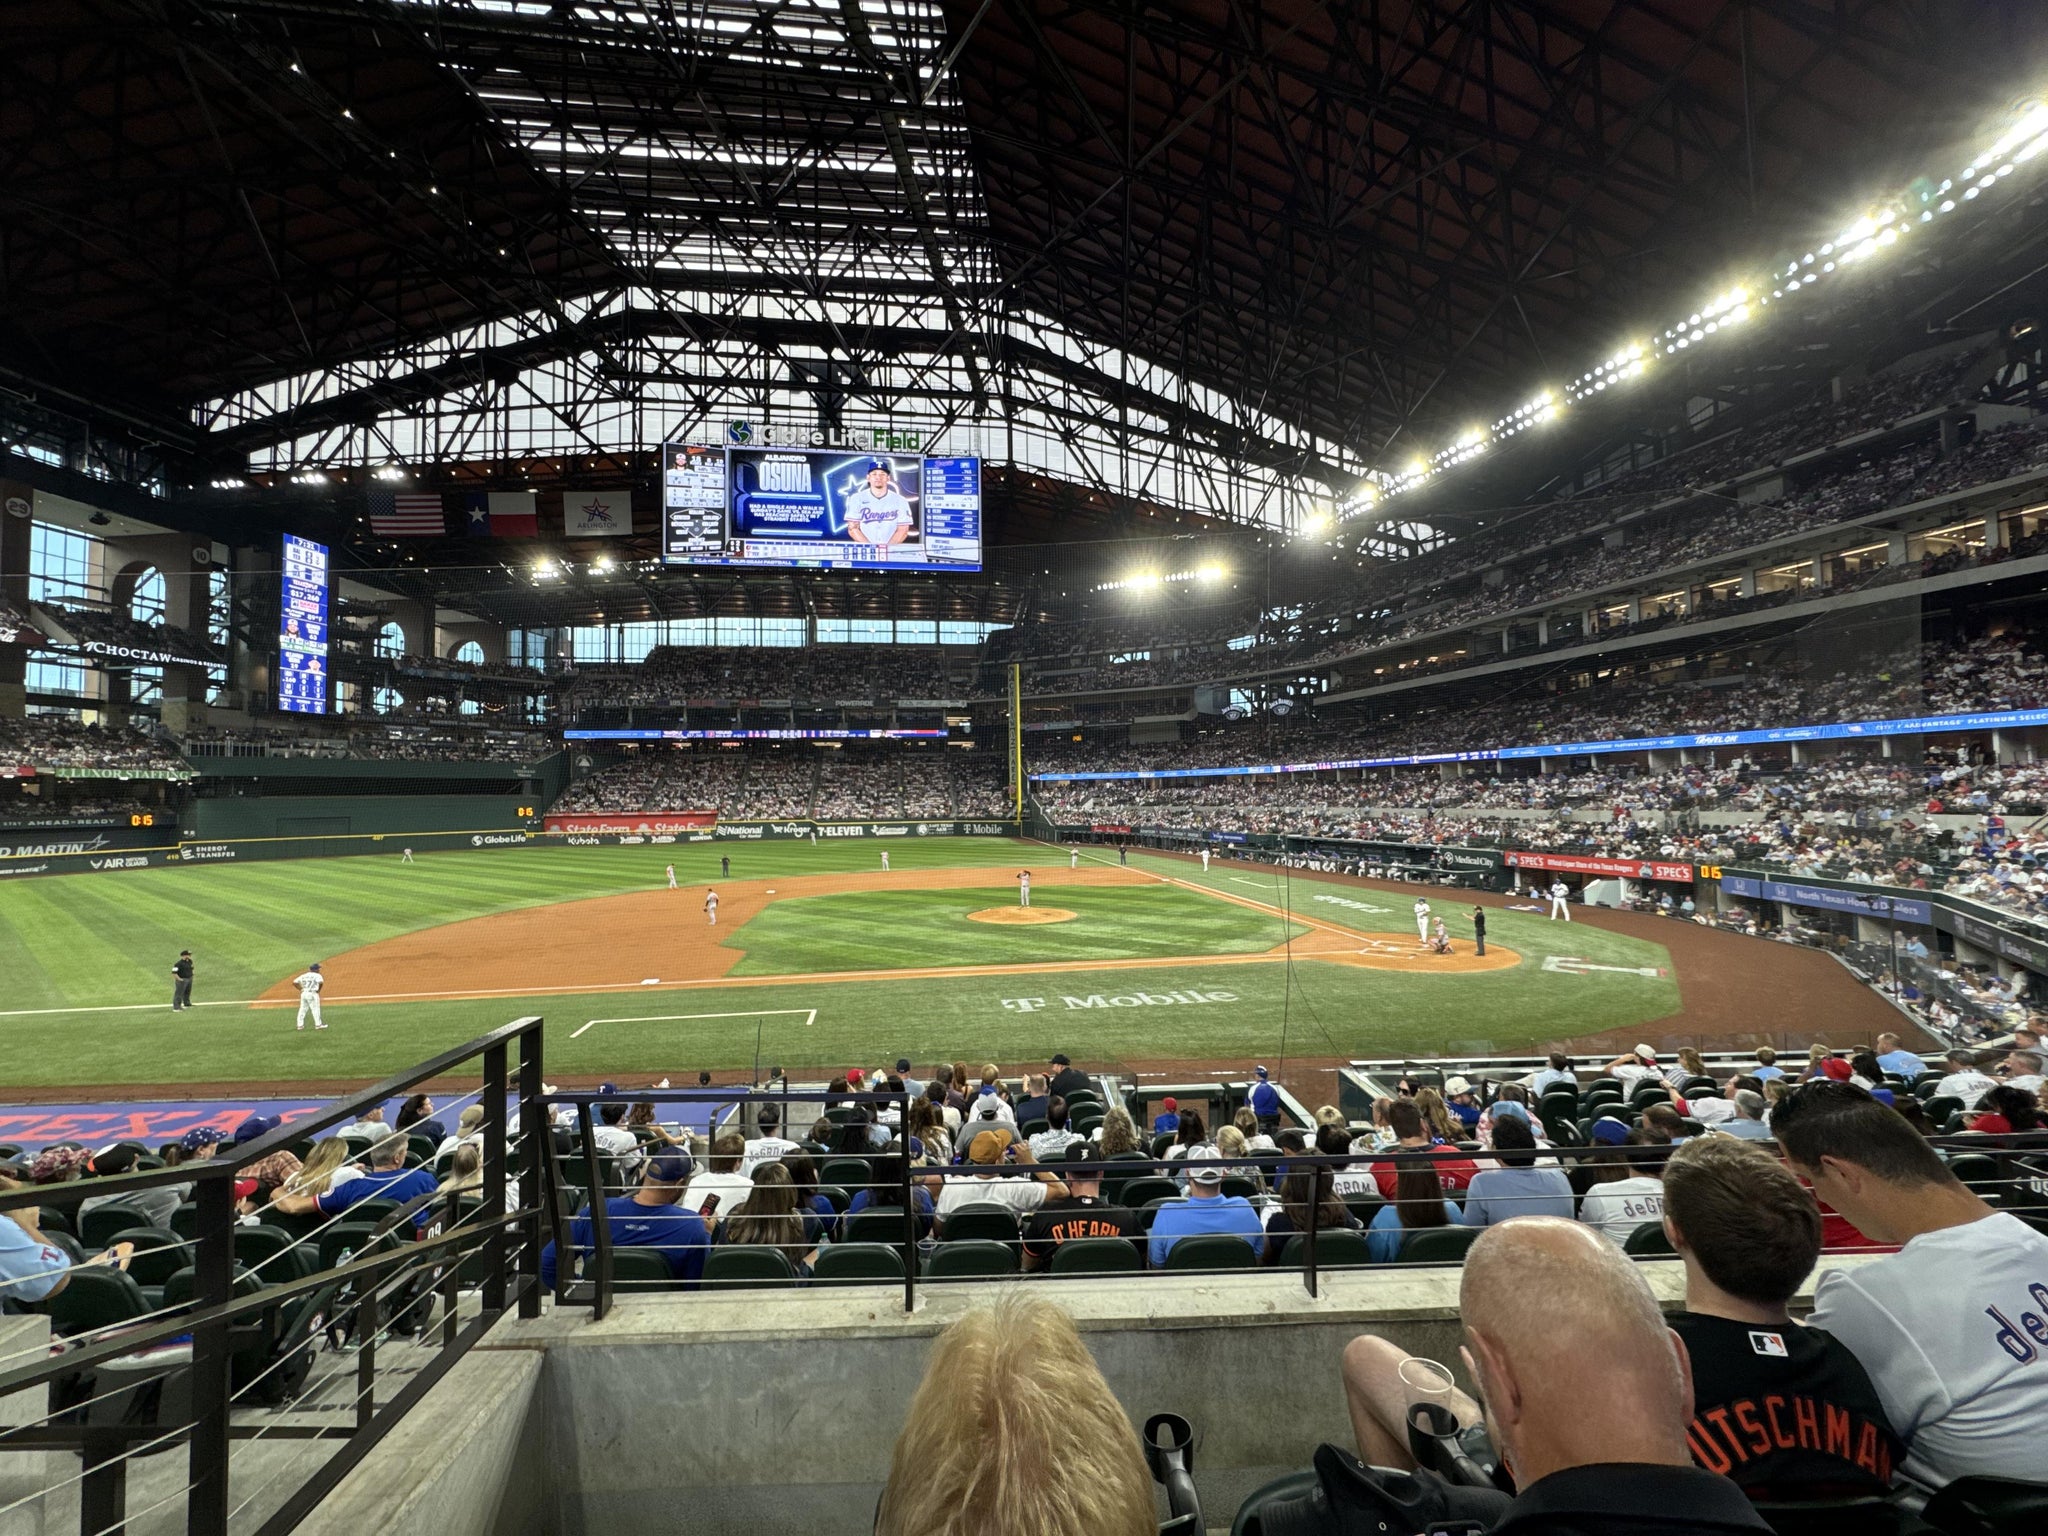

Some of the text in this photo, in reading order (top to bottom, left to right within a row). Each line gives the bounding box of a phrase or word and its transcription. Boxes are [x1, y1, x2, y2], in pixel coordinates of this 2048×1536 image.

[760, 425, 919, 450] Globe Life Field
[760, 462, 812, 492] OSUNA
[860, 508, 898, 523] Rangers
[94, 642, 172, 662] CHOCTAW
[600, 699, 646, 707] DALLAS
[1968, 716, 2016, 725] PLATINUM
[1695, 735, 1738, 745] TRAVEL ON
[71, 769, 189, 780] LUXOR STAFFING
[77, 818, 116, 826] READY
[727, 826, 763, 836] National
[784, 822, 811, 838] Kroger
[818, 826, 864, 836] 7-ELEVEN
[973, 824, 1003, 834] Mobile
[484, 836, 509, 844] Globe
[511, 834, 526, 843] Life
[568, 837, 600, 846] Kubota
[690, 834, 713, 842] HONDA
[16, 843, 84, 857] MARTIN
[104, 858, 123, 869] AIR
[1454, 855, 1494, 868] Medical City
[1520, 855, 1544, 866] SPEC'S
[1657, 866, 1690, 879] SPEC'S
[1796, 890, 1919, 916] North Texas Hona Dalers
[1001, 990, 1239, 1013] T Mobile
[1052, 1220, 1120, 1244] O'HEARN
